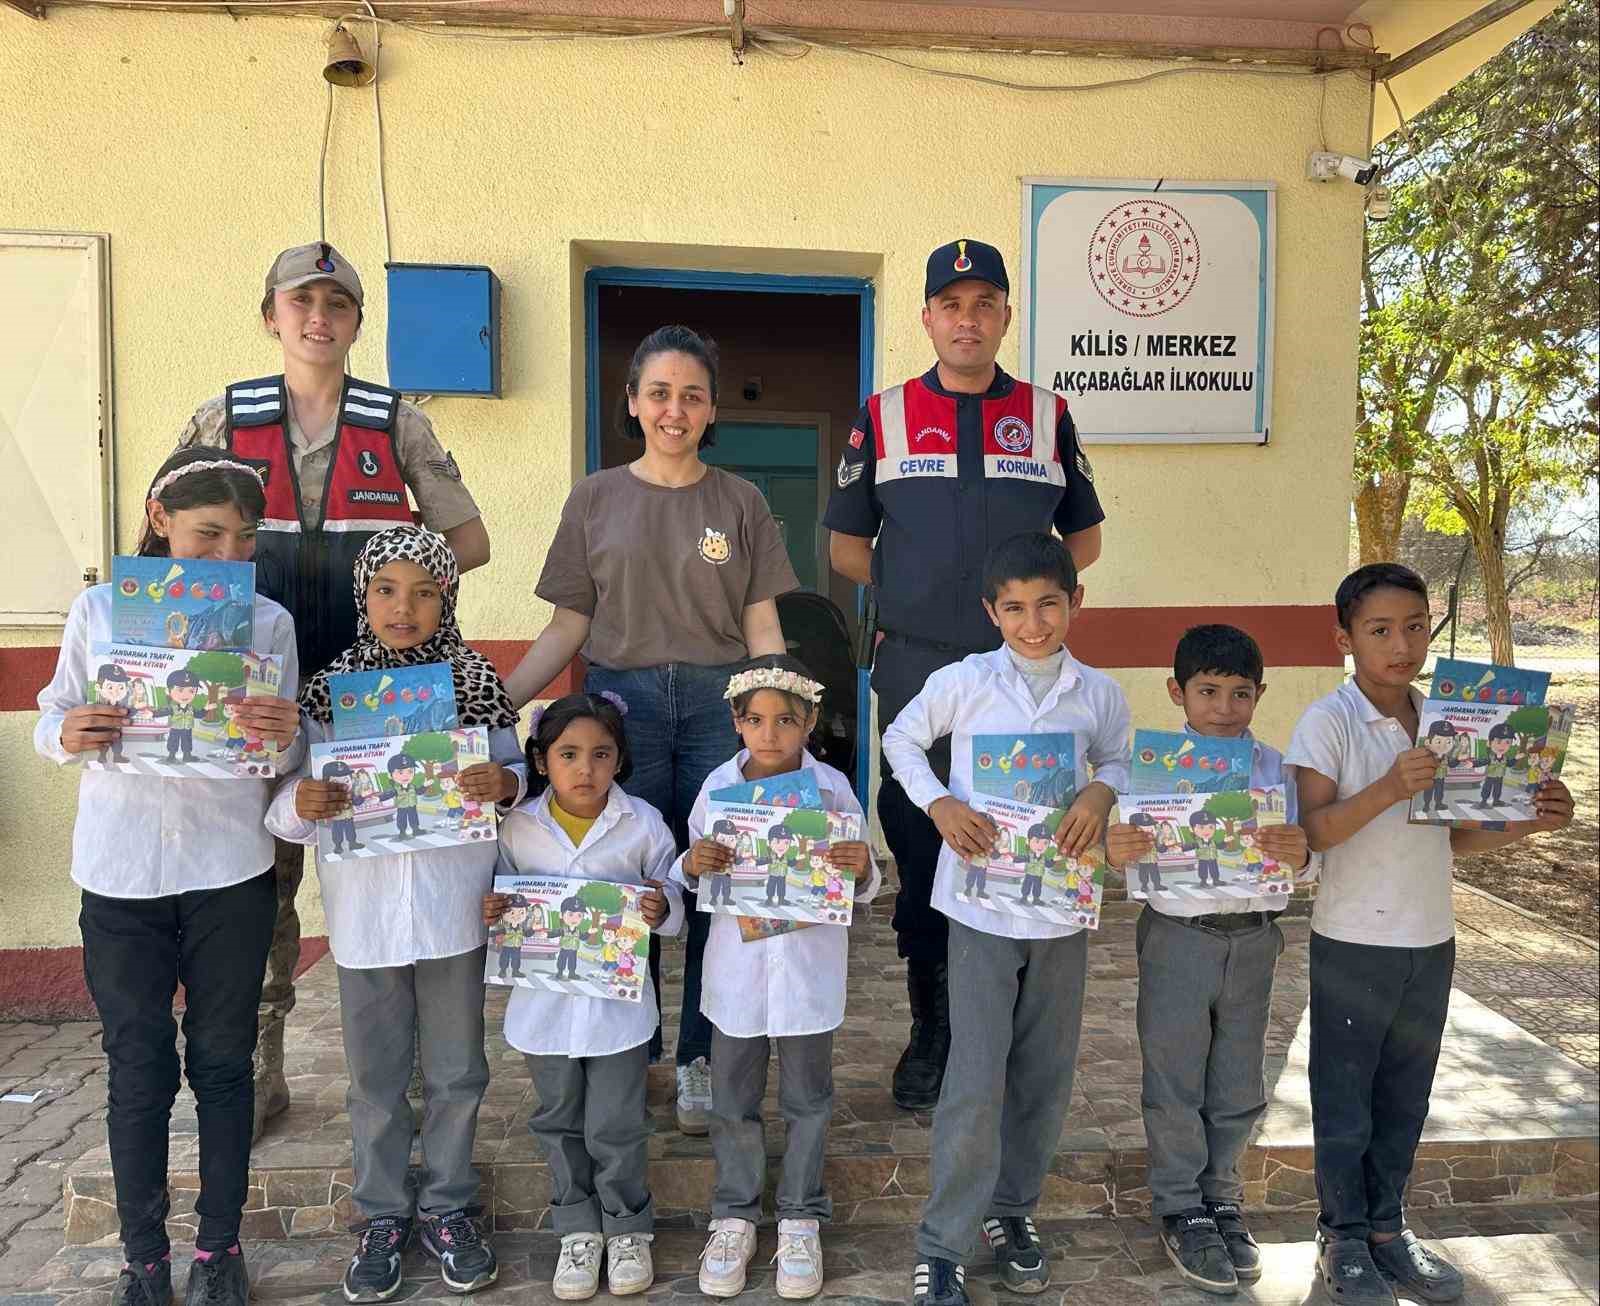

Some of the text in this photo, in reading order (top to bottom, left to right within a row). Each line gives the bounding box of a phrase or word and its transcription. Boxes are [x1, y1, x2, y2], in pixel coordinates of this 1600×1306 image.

[1071, 329, 1237, 357] KİLİS / MERKEZ
[1052, 366, 1254, 396] AKÇABAĞLAR İLKOKULU
[915, 426, 952, 443] JANDARMA
[900, 459, 1048, 478] ÇEVRE KORUMA
[352, 491, 400, 503] JANDARMA
[1187, 1216, 1214, 1225] LACOSTE
